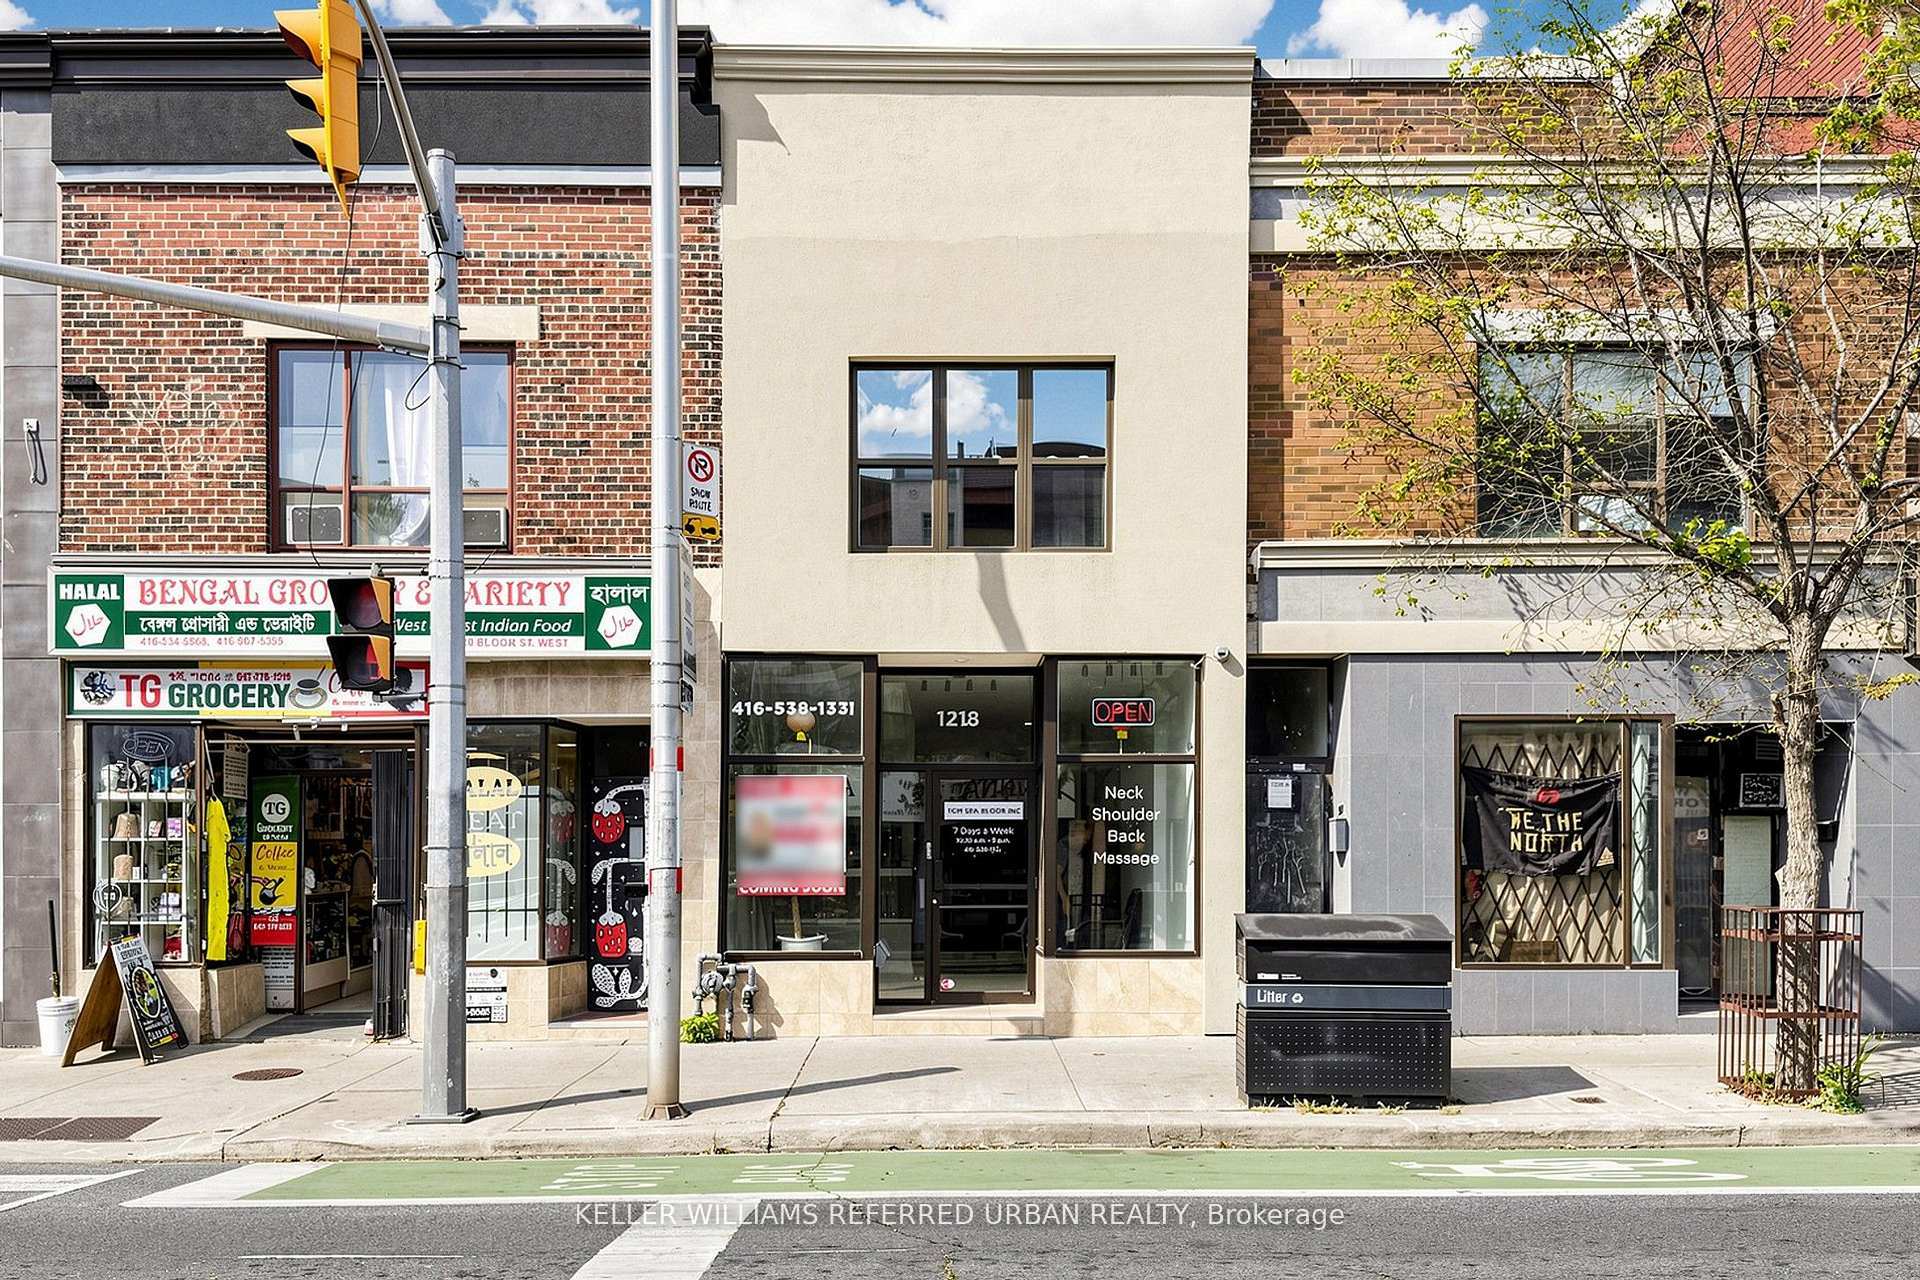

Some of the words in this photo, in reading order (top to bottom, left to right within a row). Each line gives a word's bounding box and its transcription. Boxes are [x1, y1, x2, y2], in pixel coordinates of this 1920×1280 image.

[689, 499, 711, 512] ROUTE
[59, 583, 121, 600] HALAL
[139, 579, 260, 605] BENGAL
[415, 579, 431, 606] &
[465, 580, 571, 606] ARIETY
[480, 617, 527, 632] Indian
[532, 617, 571, 632] Food
[477, 637, 516, 647] BLOOR
[520, 637, 535, 647] ST.
[538, 638, 568, 647] WEST
[119, 674, 162, 708] TG
[168, 683, 290, 709] GROCERY
[731, 701, 855, 716] 416-538-1331
[1095, 702, 1152, 723] OPEN
[936, 710, 980, 727] 1218
[1104, 785, 1144, 800] Neck
[264, 802, 287, 816] TG
[1092, 807, 1160, 822] Shoulder
[1541, 811, 1584, 832] THE
[960, 826, 981, 836] Days
[989, 826, 1015, 835] Week
[1107, 829, 1145, 843] Back
[1510, 831, 1583, 852] NORTH
[1093, 852, 1160, 867] Message
[1257, 989, 1288, 1003] Litter
